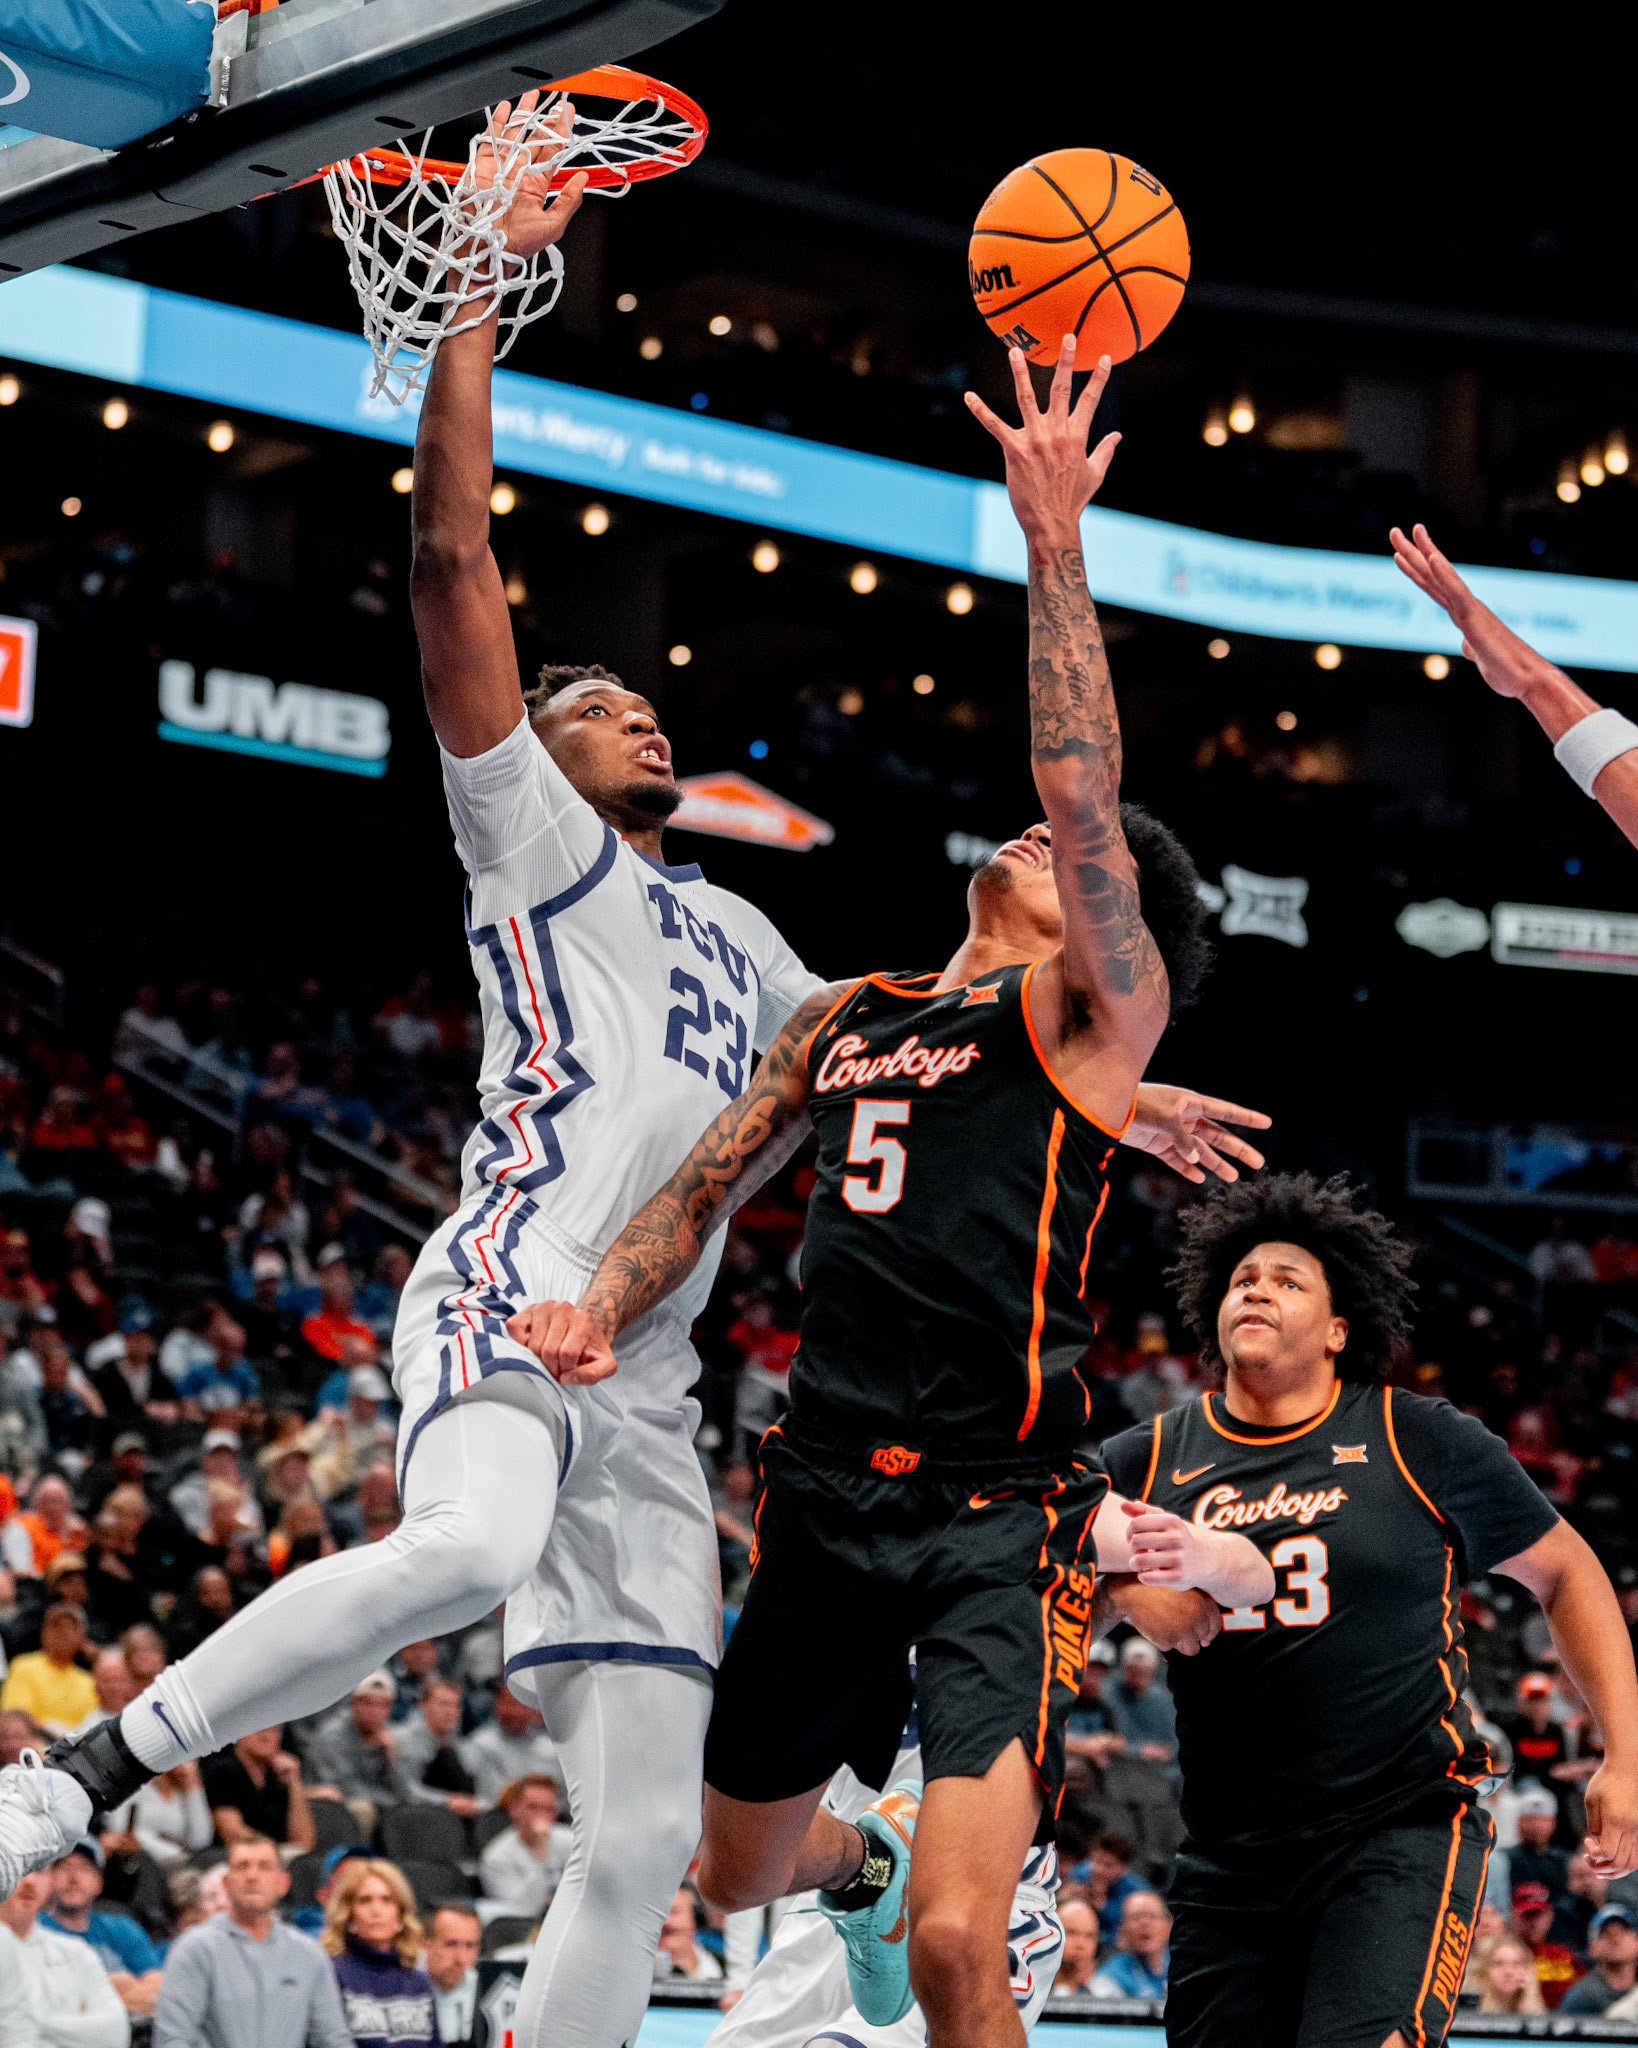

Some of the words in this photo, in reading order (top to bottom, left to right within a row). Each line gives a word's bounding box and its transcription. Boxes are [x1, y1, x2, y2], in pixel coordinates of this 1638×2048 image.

[157, 659, 391, 760] UMB
[647, 883, 748, 996] TCU
[663, 966, 747, 1104] 23
[815, 1033, 981, 1093] Cowboys
[841, 1098, 911, 1214] 5
[1193, 1482, 1349, 1530] Cowboys
[1053, 1568, 1091, 1696] POKES
[1221, 1535, 1331, 1632] 3
[1432, 1912, 1468, 2012] POKES
